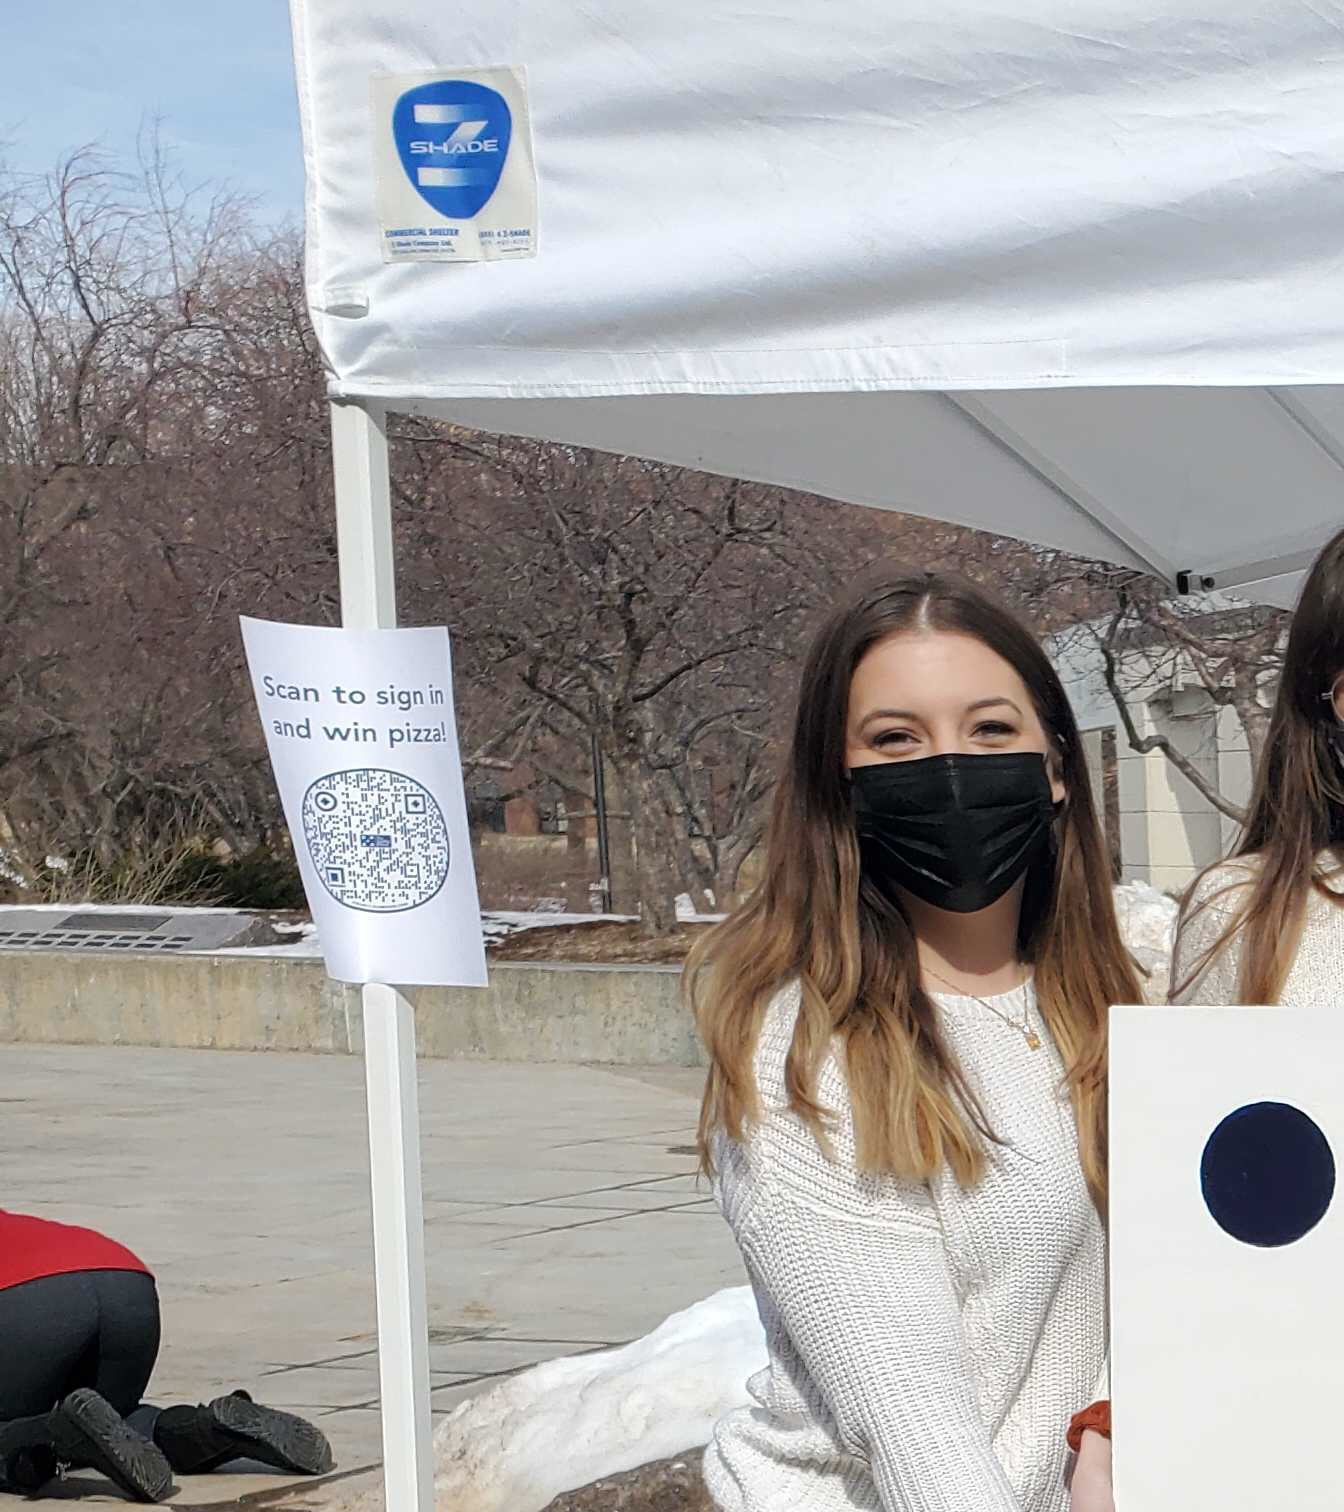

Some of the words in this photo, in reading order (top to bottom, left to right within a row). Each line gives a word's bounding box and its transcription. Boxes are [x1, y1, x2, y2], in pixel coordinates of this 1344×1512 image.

[409, 140, 499, 155] SHADE
[263, 675, 320, 703] Scan
[332, 686, 366, 705] to
[376, 684, 424, 711] sign
[428, 684, 444, 705] in
[273, 717, 312, 740] and
[322, 721, 377, 743] win
[388, 721, 447, 749] pizza!
